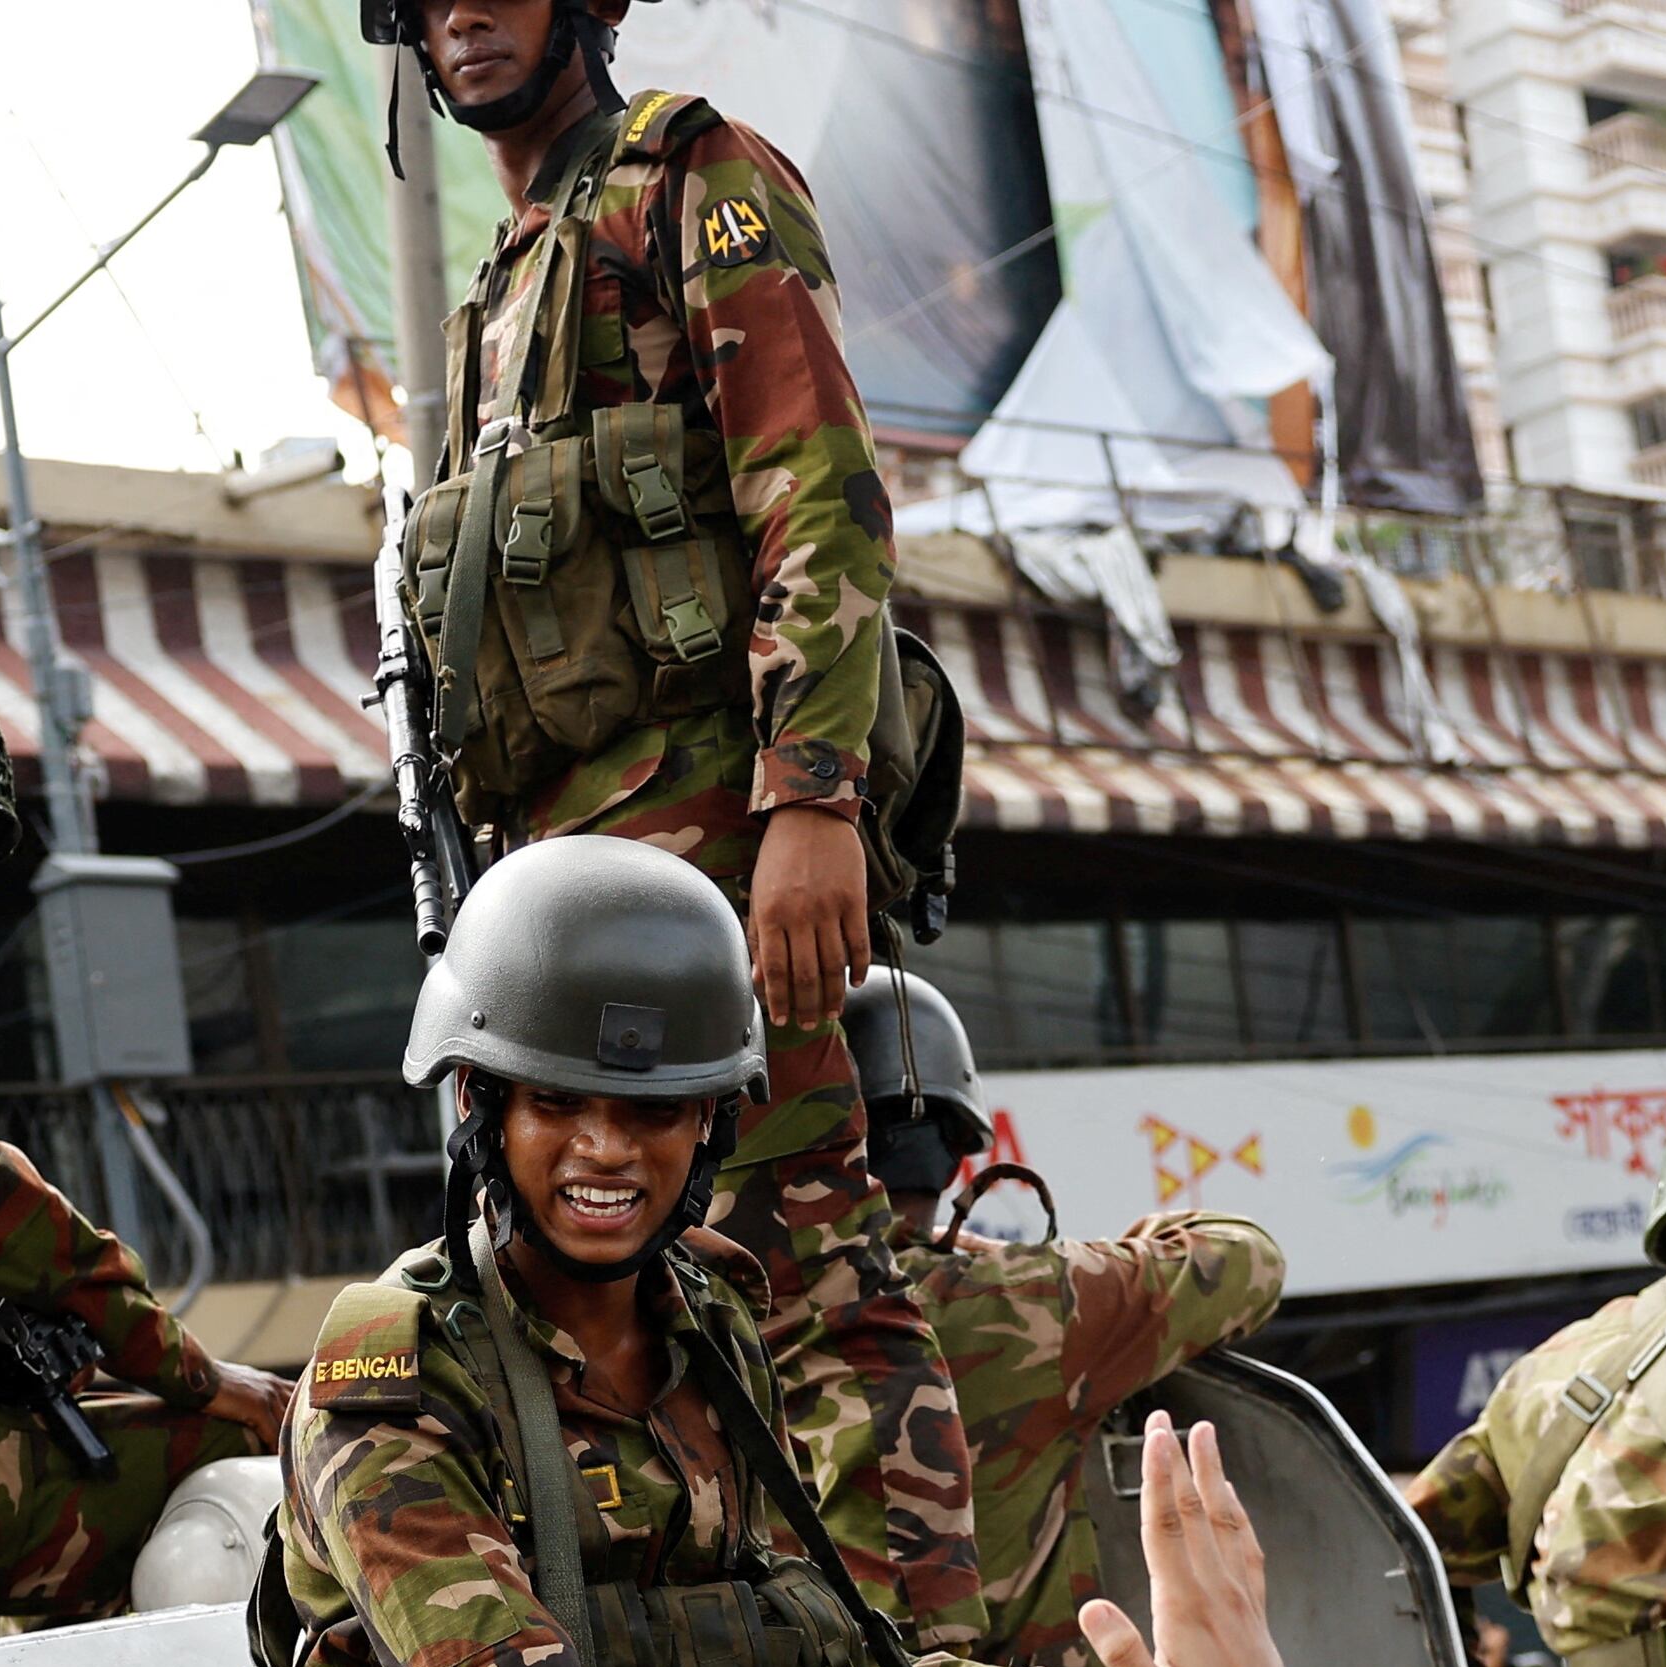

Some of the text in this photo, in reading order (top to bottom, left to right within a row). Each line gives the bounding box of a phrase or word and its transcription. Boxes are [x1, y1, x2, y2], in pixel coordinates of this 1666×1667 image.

[626, 132, 642, 142] E
[316, 1356, 413, 1383] E BENGAL
